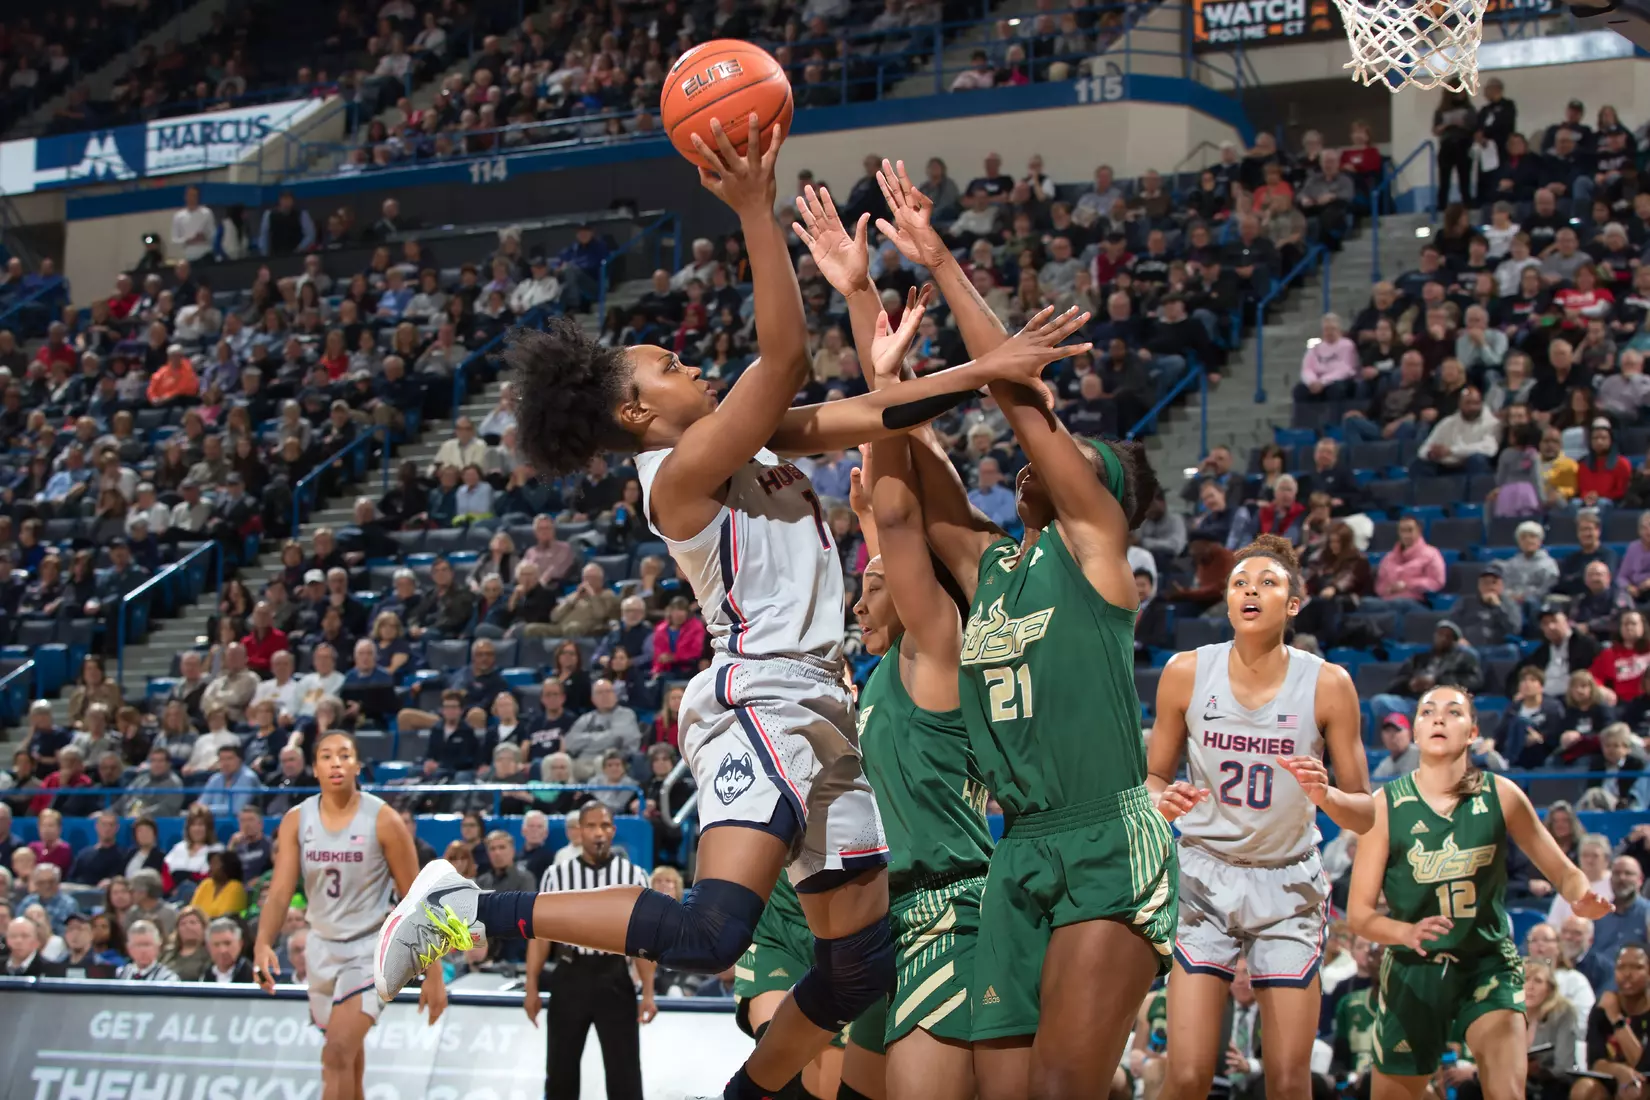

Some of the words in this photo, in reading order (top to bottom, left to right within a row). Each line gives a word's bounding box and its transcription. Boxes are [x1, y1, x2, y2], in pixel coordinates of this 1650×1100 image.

[1204, 0, 1306, 27] WATCH
[1243, 23, 1267, 39] ME
[1283, 20, 1306, 36] CT
[682, 58, 743, 98] ELITE
[1074, 76, 1123, 104] 115
[156, 115, 272, 151] MARCUS
[467, 155, 508, 184] 114
[800, 488, 832, 552] 1
[983, 663, 1033, 723] 21
[1203, 730, 1296, 756] HUSKIES
[1219, 759, 1274, 810] 20
[305, 850, 364, 863] HUSKIES
[1407, 832, 1497, 884] USF
[324, 866, 342, 899] 3
[1434, 880, 1477, 919] 12
[88, 1010, 155, 1041] GET
[157, 1013, 219, 1044] ALL
[466, 1023, 520, 1055] AT
